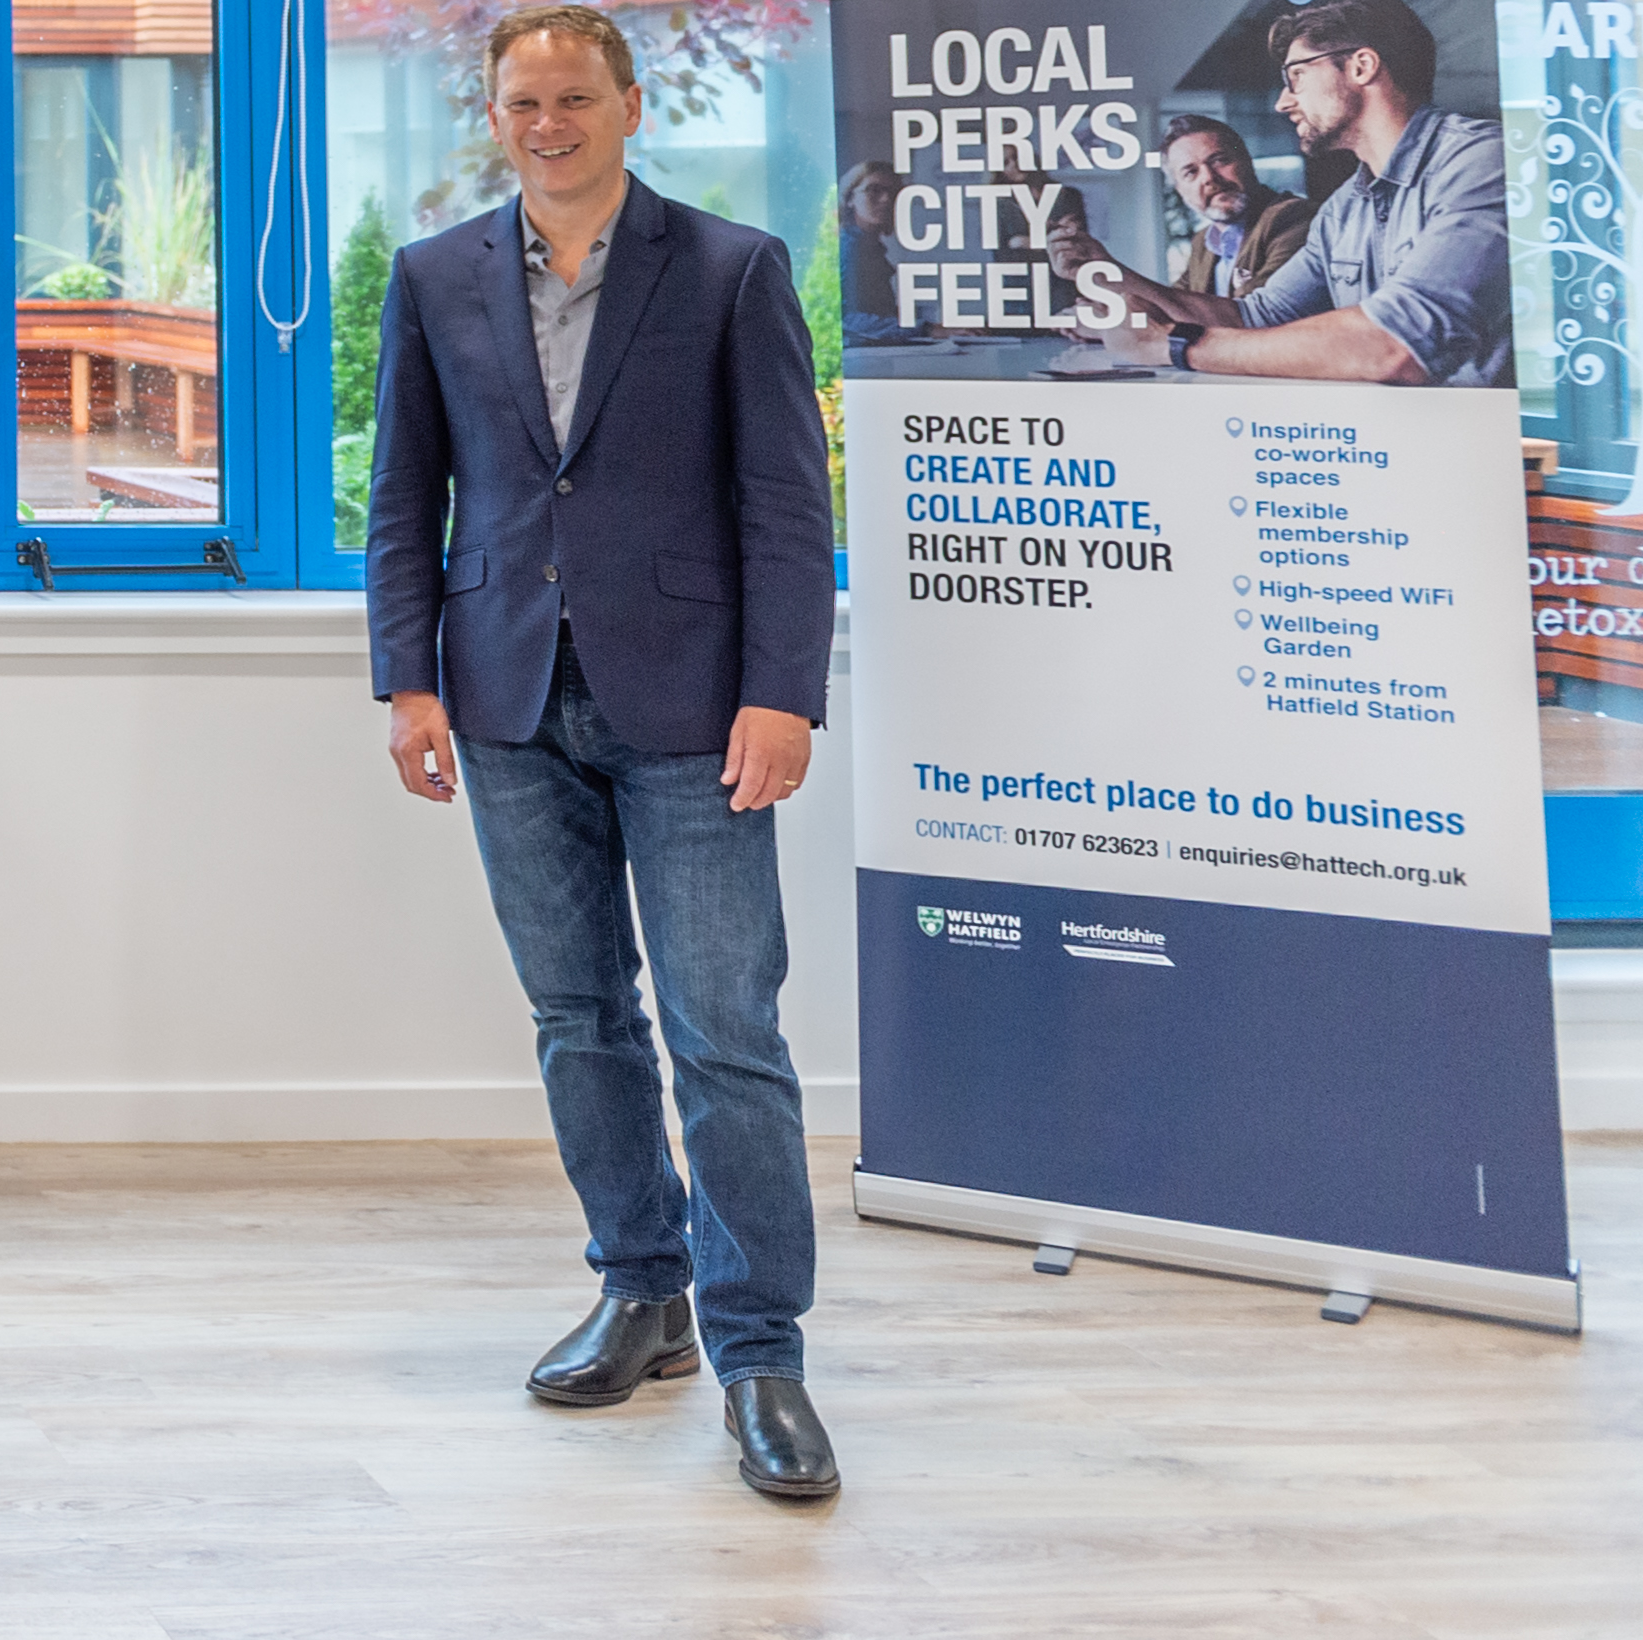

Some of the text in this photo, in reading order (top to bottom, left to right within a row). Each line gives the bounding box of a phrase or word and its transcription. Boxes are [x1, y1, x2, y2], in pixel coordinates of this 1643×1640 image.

[1496, 1, 1643, 59] GAR
[892, 26, 1132, 96] LOCAL
[894, 103, 1161, 172] PERKS.
[897, 185, 1061, 250] CITY
[899, 262, 1146, 329] FEELS.
[904, 415, 1064, 446] SPACE TO
[1252, 422, 1356, 444] Inspiring
[906, 454, 1115, 487] CREATE AND
[1255, 447, 1388, 468] co-working
[1256, 471, 1340, 488] spaces
[907, 493, 1160, 536] COLLABORATE,
[1256, 501, 1348, 520] Flexible
[1259, 526, 1408, 549] membership
[908, 533, 1172, 571] RIGHT ON YOUR
[1260, 548, 1349, 568] options
[910, 573, 1092, 608] DOORSTEP.
[1260, 580, 1453, 605] High-speed WiFi
[1260, 614, 1379, 641] Wellbeing
[1530, 598, 1643, 637] etox
[1264, 637, 1351, 658] Garden
[1264, 672, 1446, 698] 2 minutes from
[1267, 695, 1454, 723] Hatfield Station
[914, 763, 1465, 835] The perfect place to do business
[916, 819, 1467, 887] CONTACT: 01707 623623 enquiries@hattech.org.uk
[946, 910, 1021, 927] WELWYN
[948, 924, 1021, 941] HATFIELD
[1061, 921, 1165, 945] Hertfordshire
